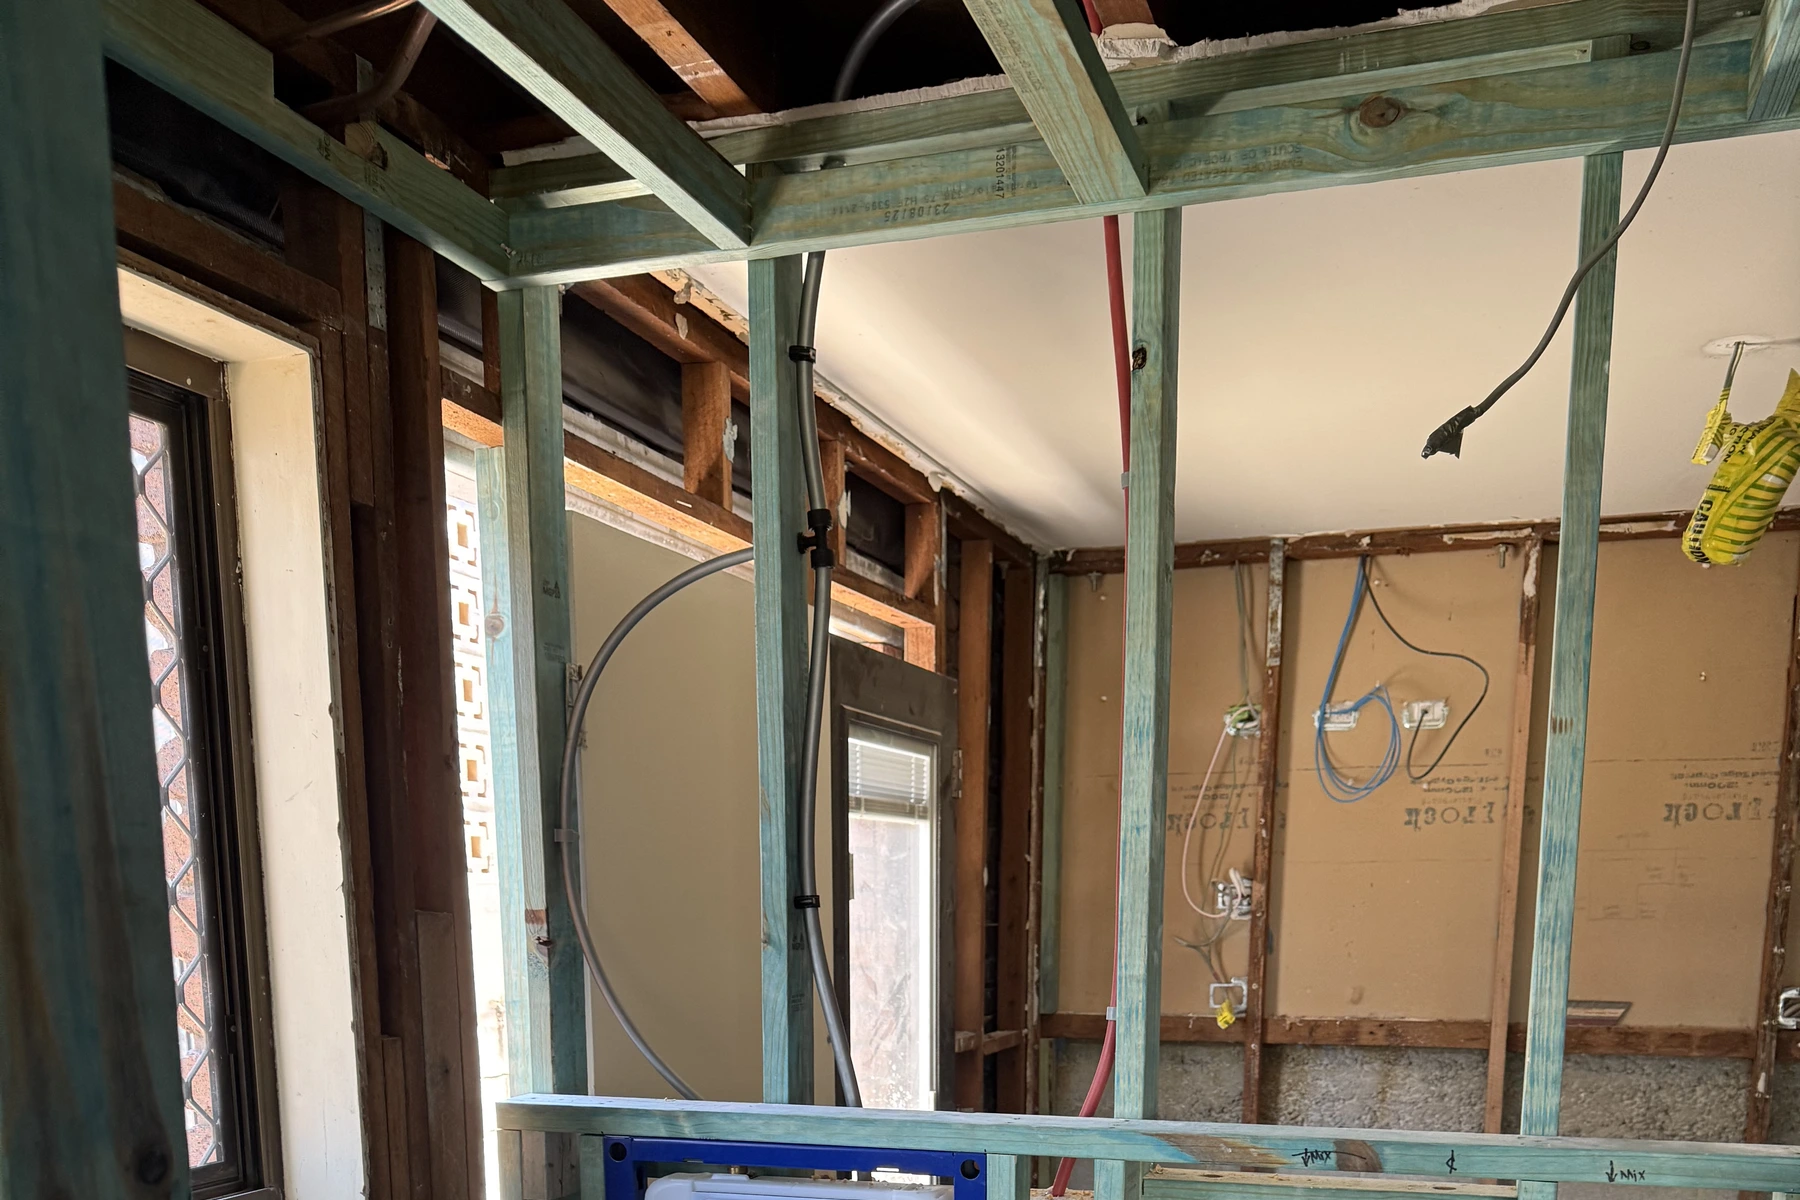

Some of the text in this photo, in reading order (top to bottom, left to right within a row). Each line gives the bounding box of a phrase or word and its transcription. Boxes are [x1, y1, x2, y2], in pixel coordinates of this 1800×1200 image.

[994, 147, 1006, 199] 13201447
[1689, 499, 1712, 564] CAUTION
[1620, 1169, 1646, 1182] Mix
